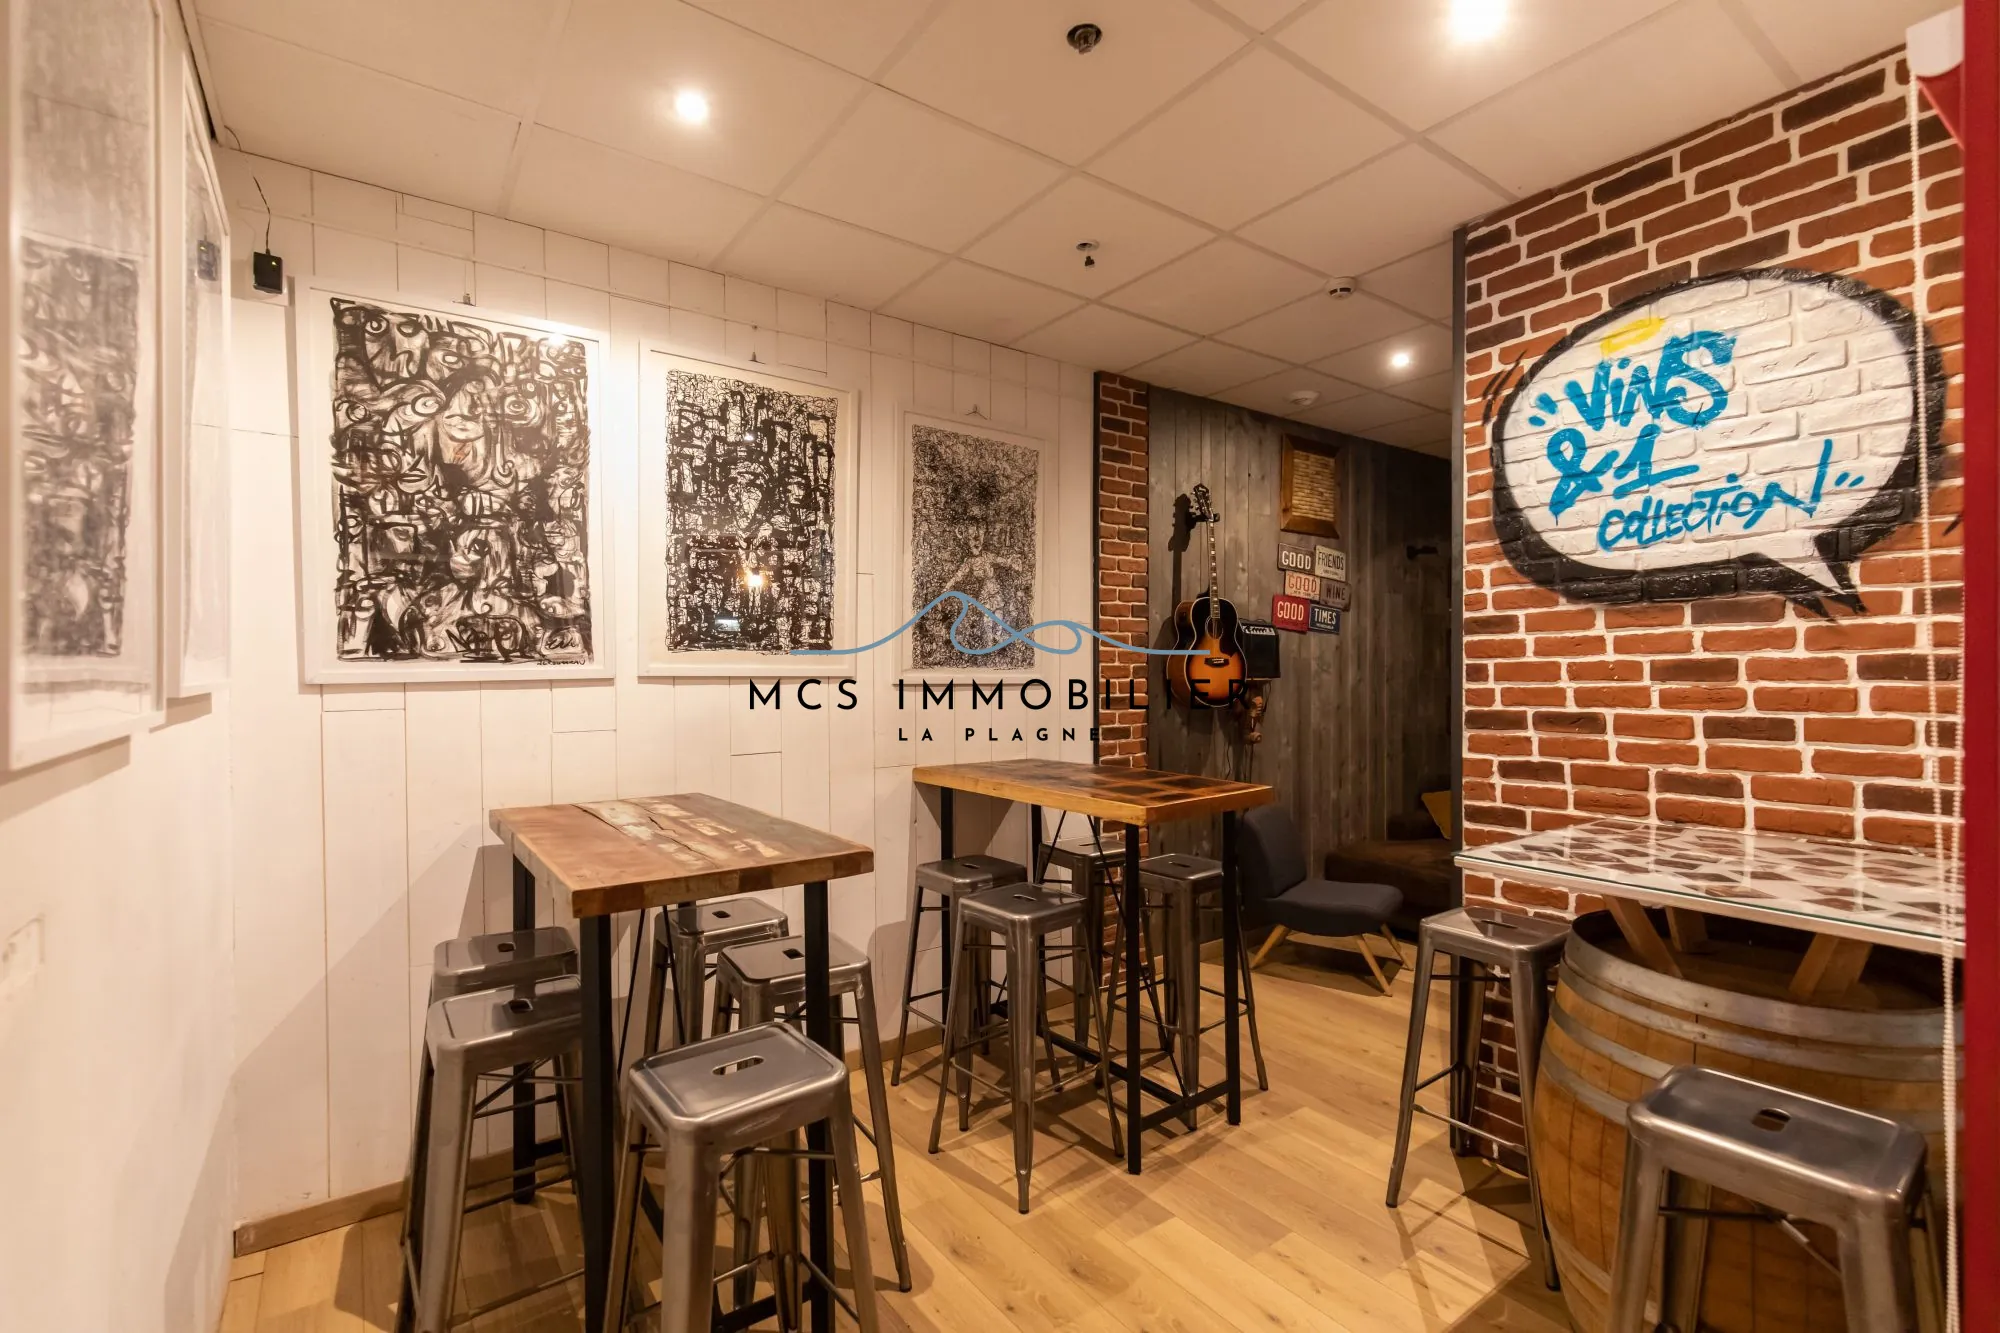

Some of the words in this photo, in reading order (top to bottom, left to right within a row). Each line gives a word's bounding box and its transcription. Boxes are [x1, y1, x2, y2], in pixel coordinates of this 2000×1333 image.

[1282, 550, 1311, 570] GOOD
[1317, 551, 1344, 571] FRIENDS
[1288, 573, 1317, 593] GOOD
[1326, 585, 1346, 601] WINE
[1277, 601, 1304, 621] GOOD
[1314, 608, 1337, 625] TIMES
